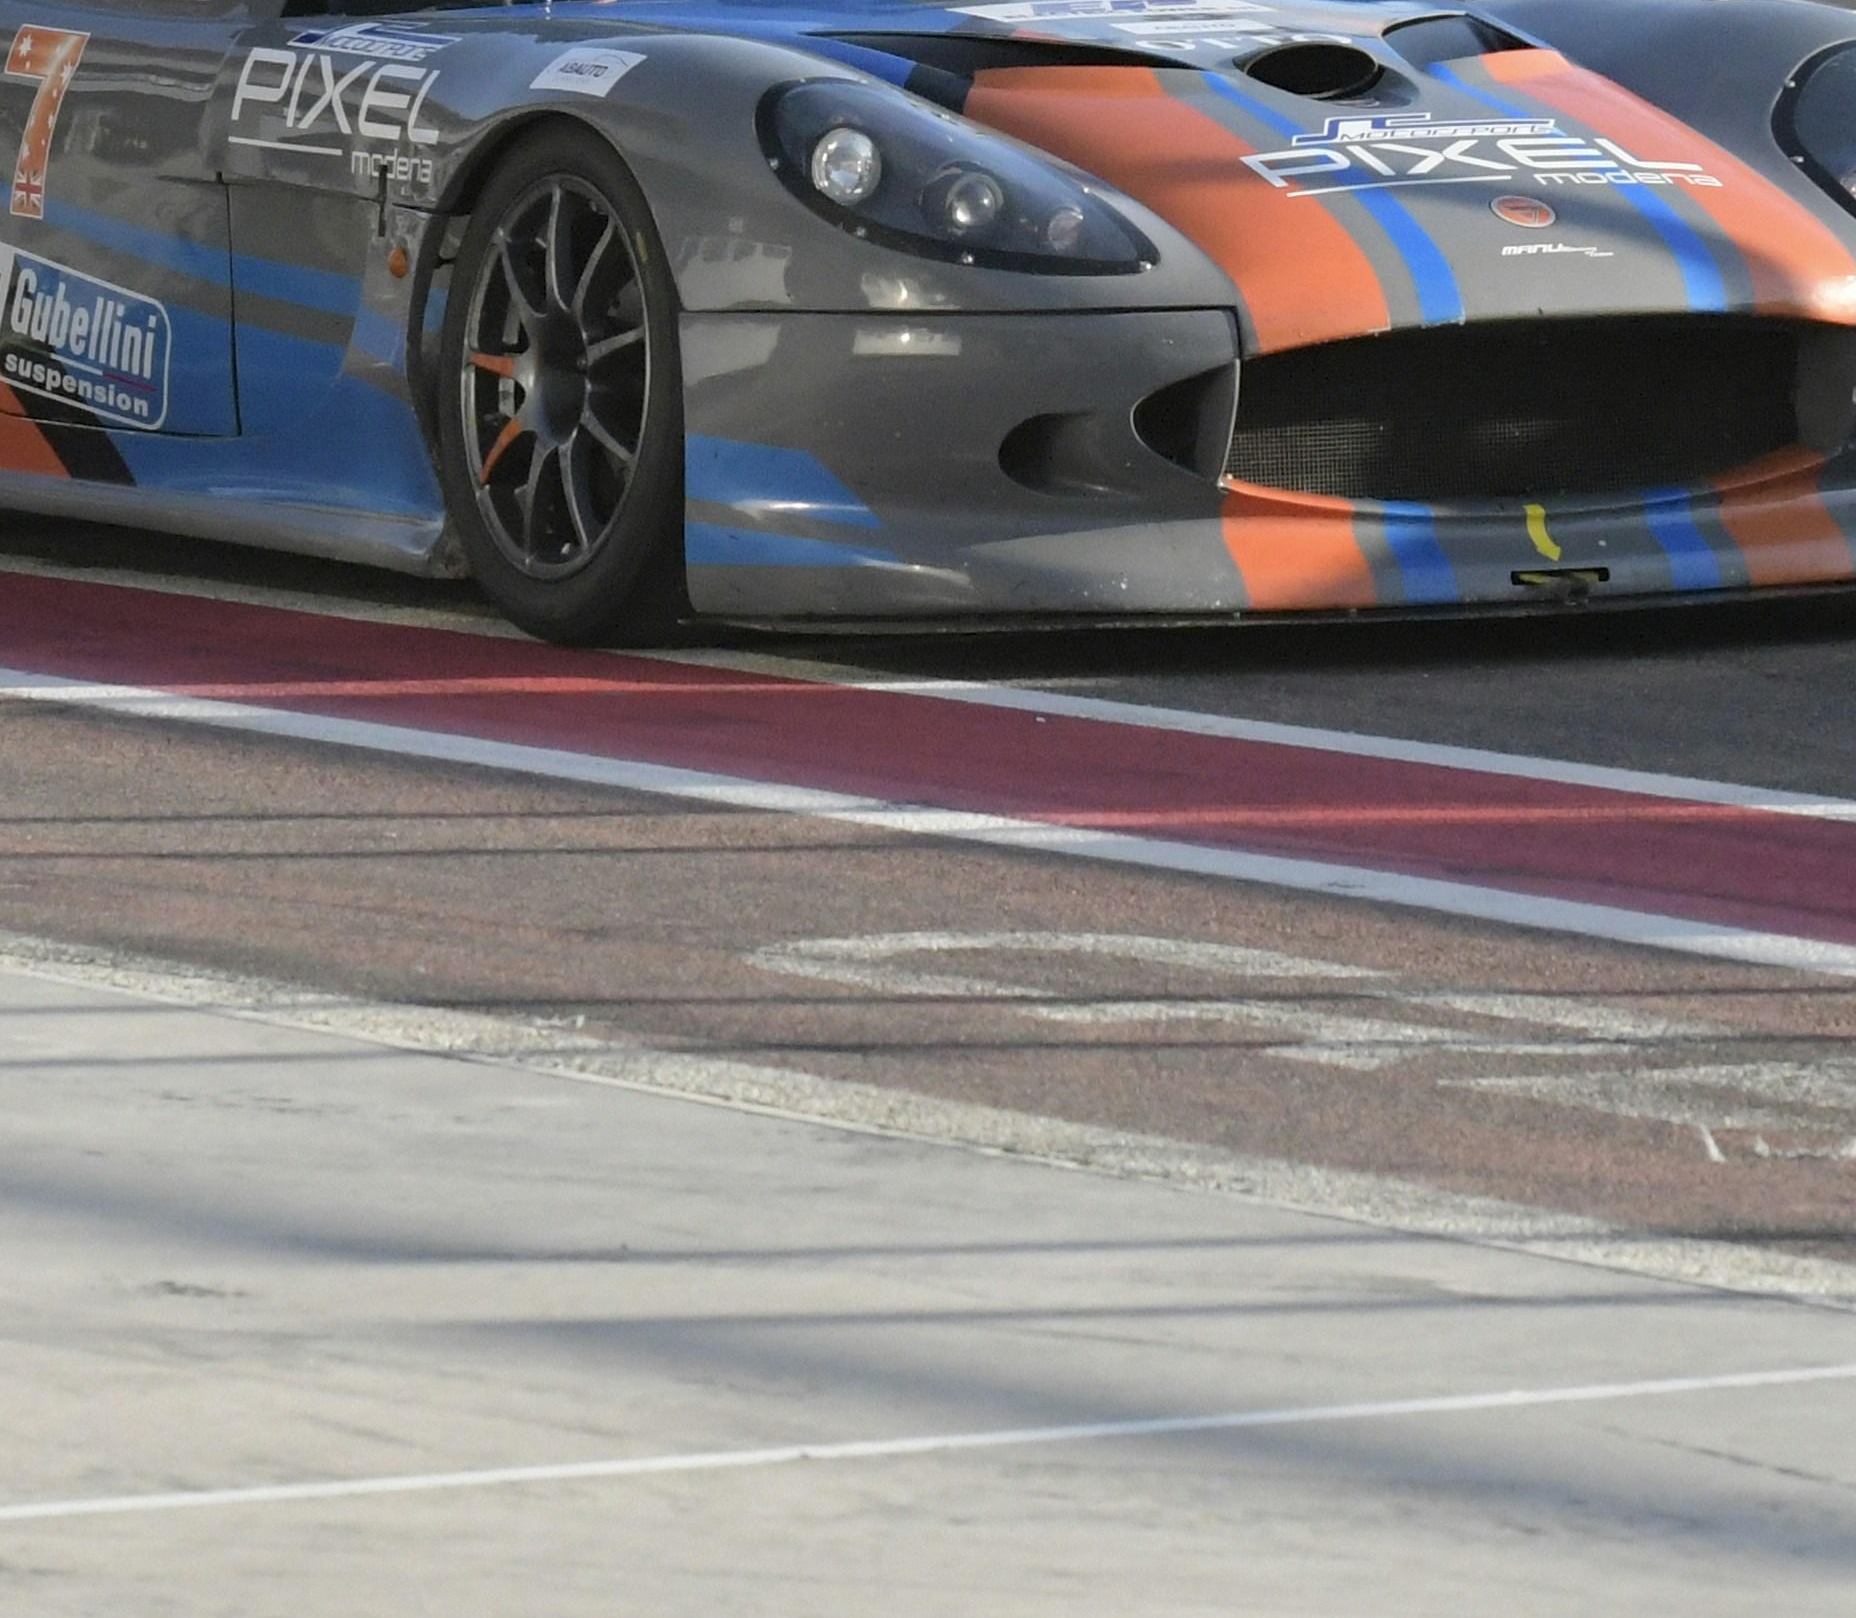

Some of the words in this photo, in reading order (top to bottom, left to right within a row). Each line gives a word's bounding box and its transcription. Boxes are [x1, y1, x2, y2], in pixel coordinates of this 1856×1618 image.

[5, 24, 91, 219] 7
[231, 48, 441, 144] PIXEL
[351, 148, 433, 183] modena
[1239, 138, 1703, 188] PIXEL
[1533, 169, 1724, 188] modena
[10, 268, 157, 380] Gubellini
[4, 353, 149, 417] suspension
